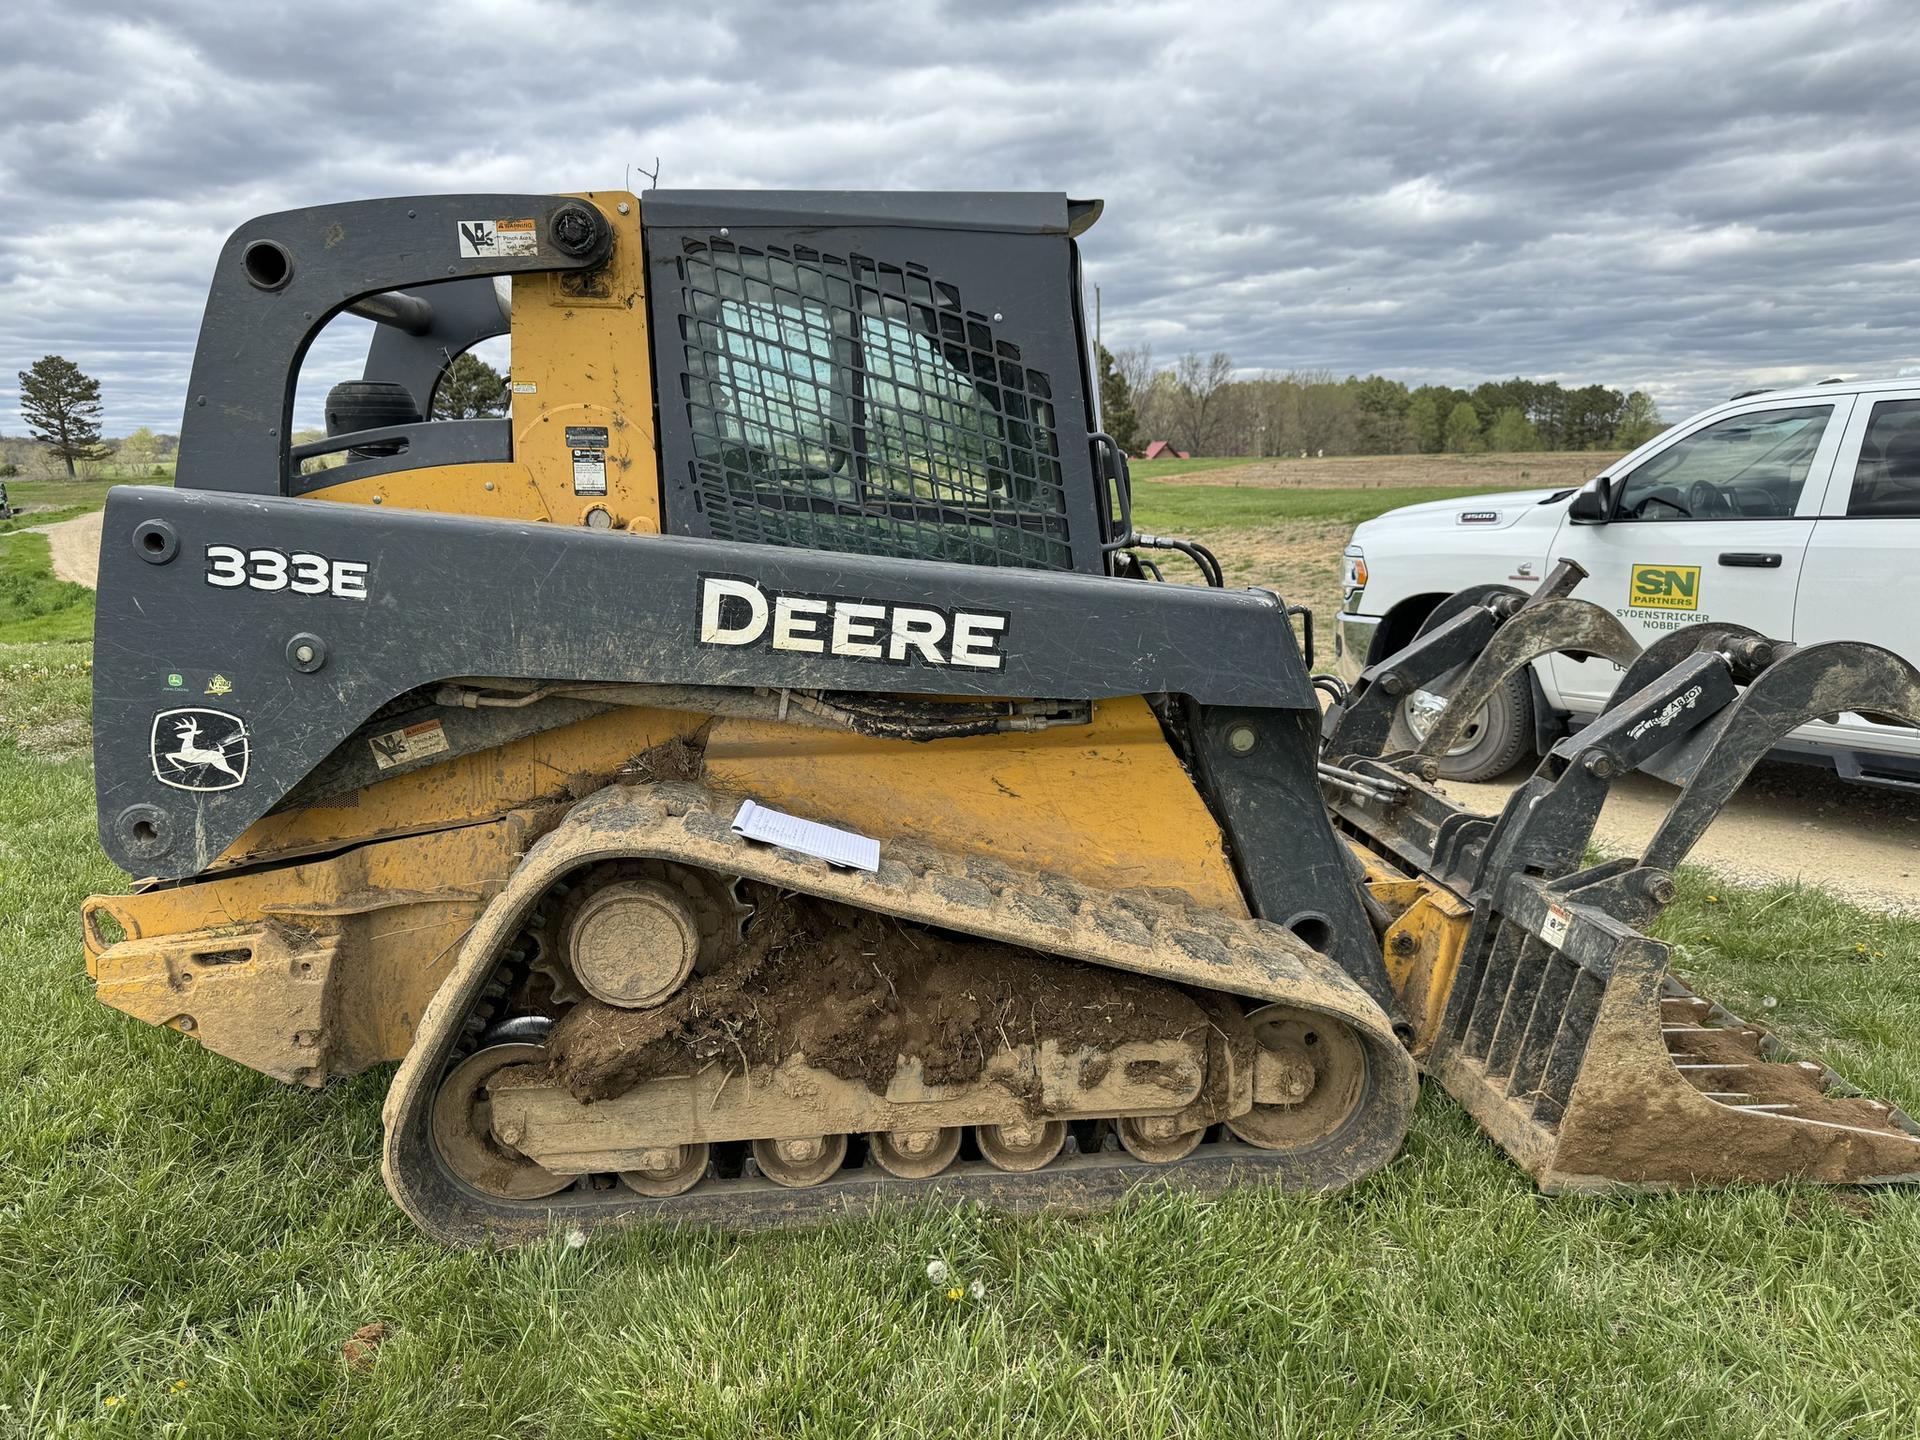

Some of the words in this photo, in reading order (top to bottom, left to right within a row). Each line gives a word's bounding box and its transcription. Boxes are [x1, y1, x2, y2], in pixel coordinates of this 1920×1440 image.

[206, 545, 369, 600] 333E
[1616, 608, 1710, 623] SYDENSTRICKER
[1633, 596, 1693, 606] PARTNERS
[700, 577, 1005, 668] DEERE
